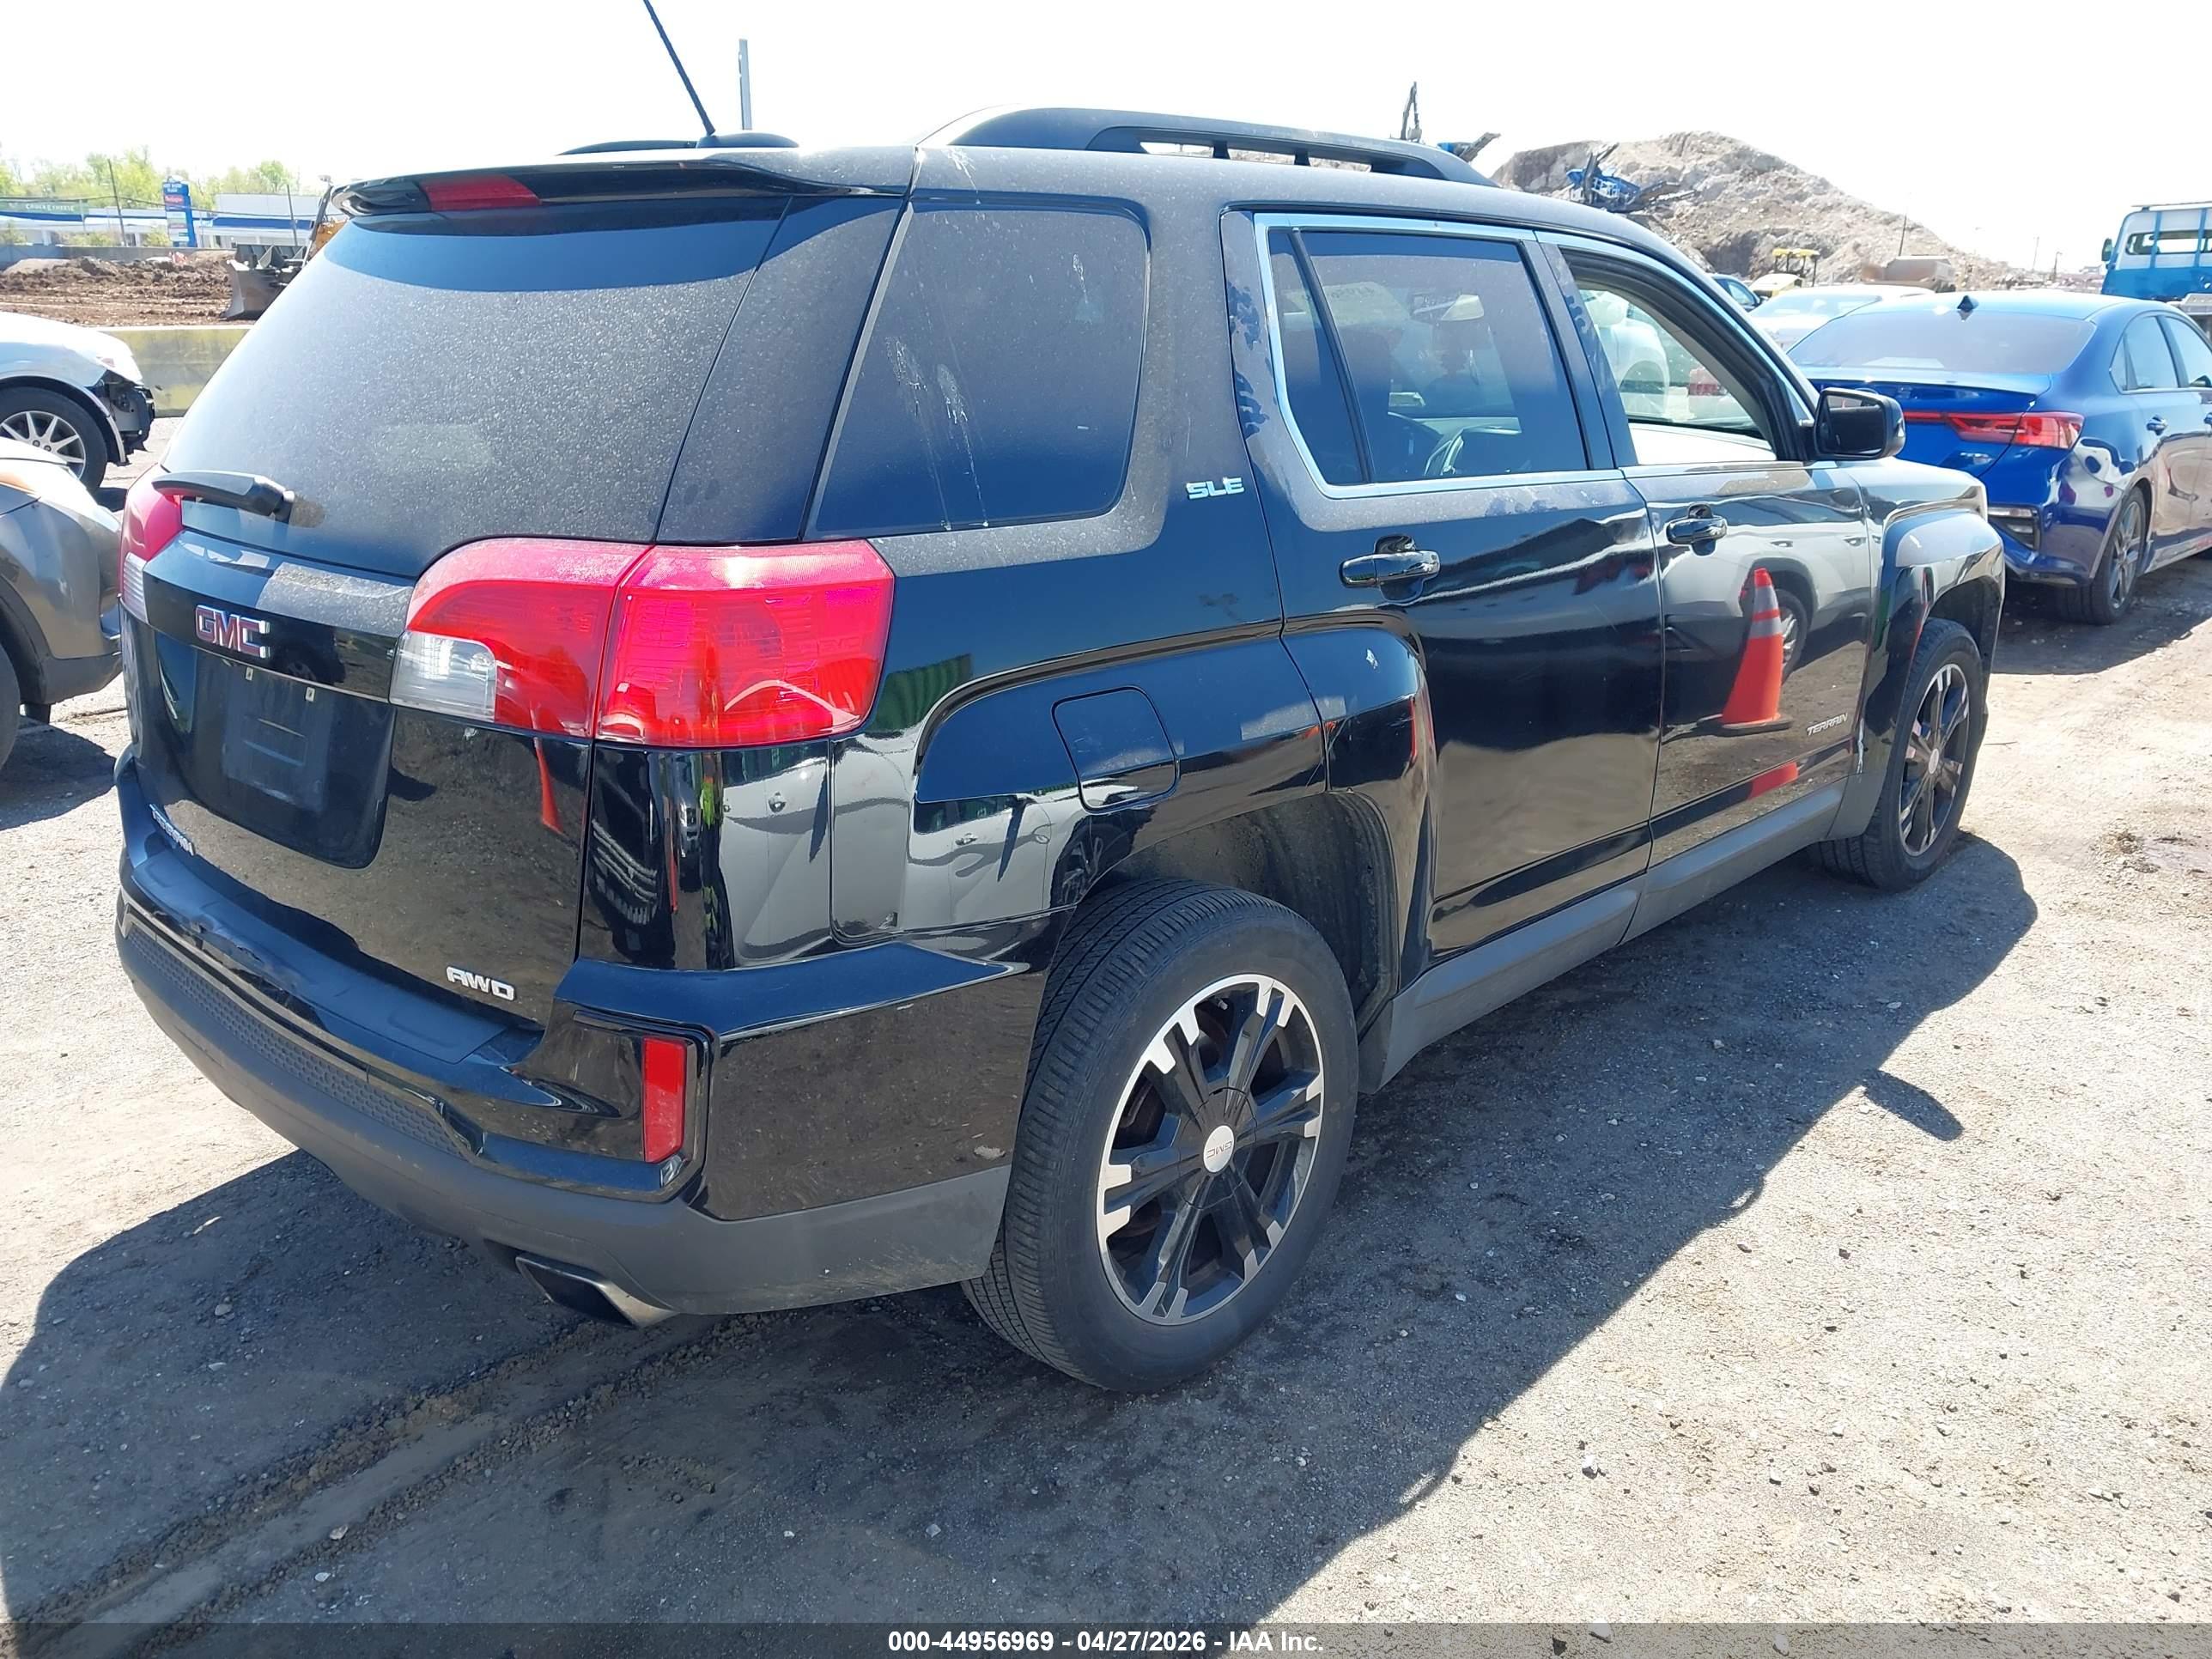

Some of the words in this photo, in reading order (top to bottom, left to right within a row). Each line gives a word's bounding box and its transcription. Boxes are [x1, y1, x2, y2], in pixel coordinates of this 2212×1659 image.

[1186, 477, 1244, 499] SLE
[196, 605, 270, 659] GMC
[1807, 713, 1848, 736] TERRAIN
[447, 966, 514, 1001] AWD
[1206, 1140, 1232, 1159] GMC
